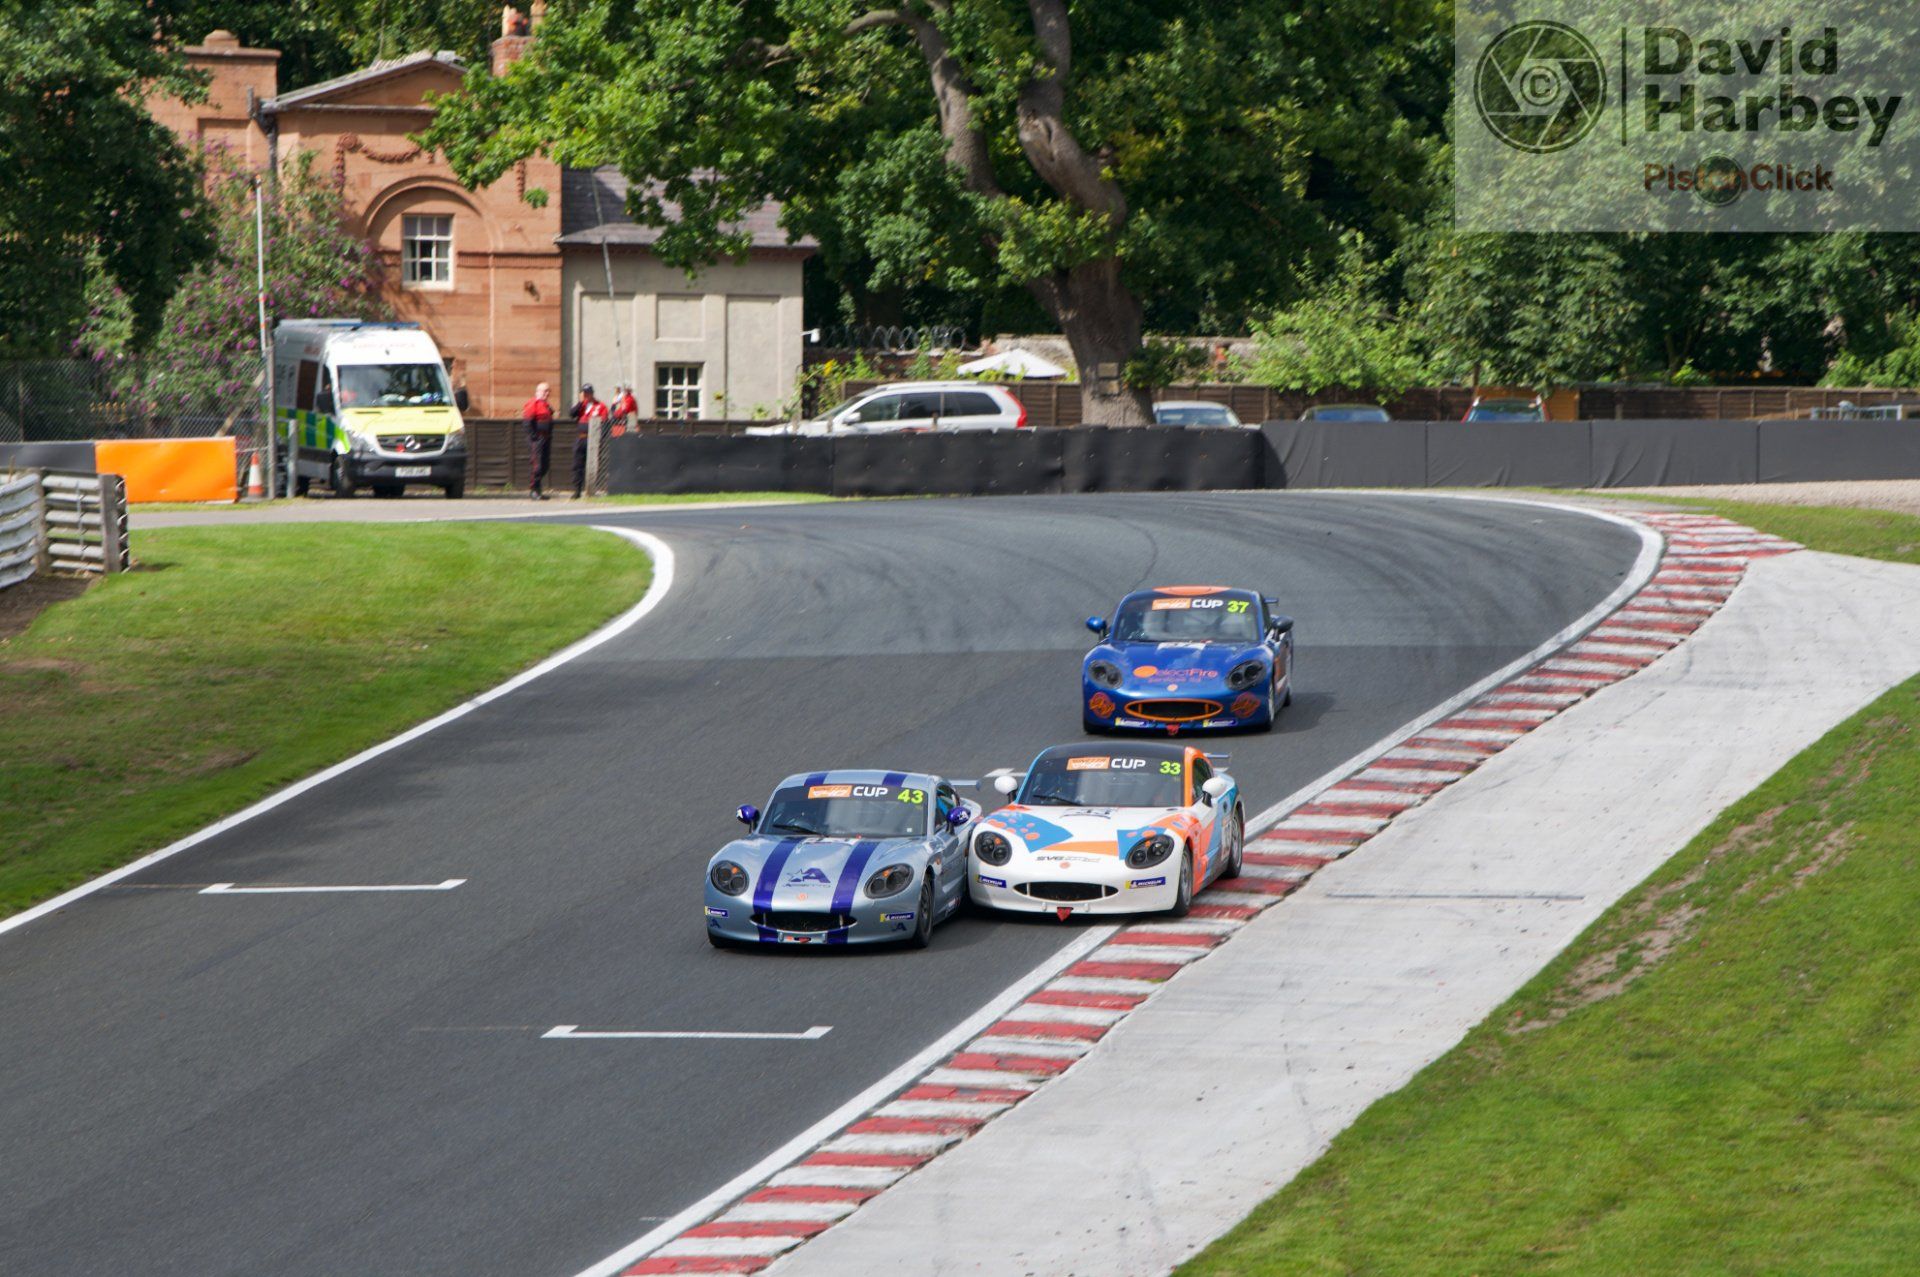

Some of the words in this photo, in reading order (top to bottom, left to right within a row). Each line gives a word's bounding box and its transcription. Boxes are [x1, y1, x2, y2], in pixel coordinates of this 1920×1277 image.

[1191, 599, 1224, 609] CUP
[1227, 600, 1249, 613] 37
[1111, 758, 1146, 770] CUP
[1160, 761, 1181, 775] 33
[853, 786, 889, 797] CUP
[897, 789, 924, 804] 43
